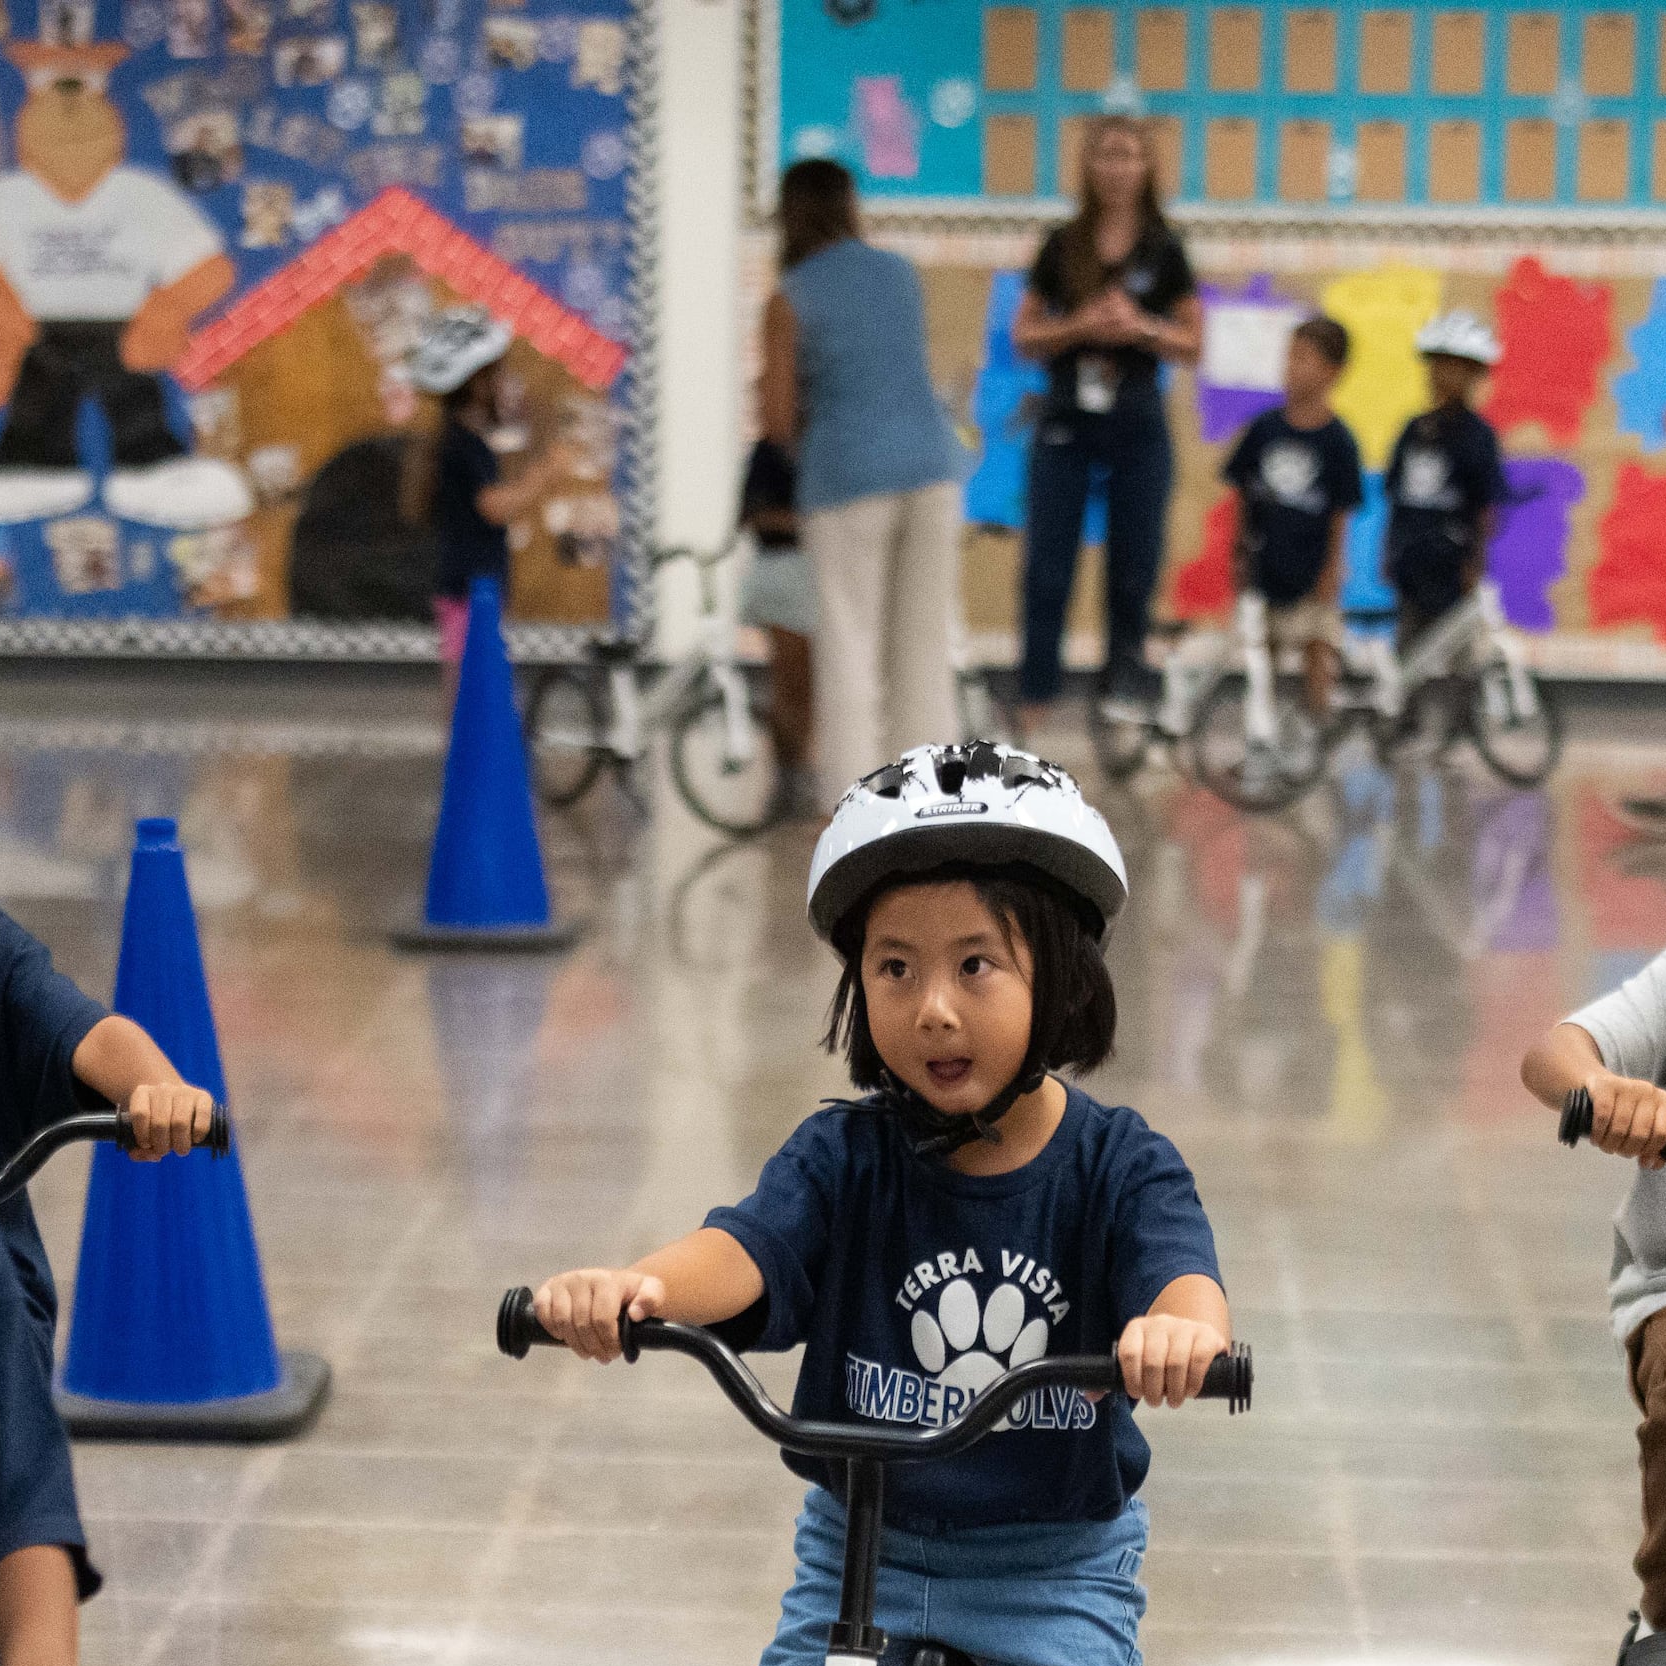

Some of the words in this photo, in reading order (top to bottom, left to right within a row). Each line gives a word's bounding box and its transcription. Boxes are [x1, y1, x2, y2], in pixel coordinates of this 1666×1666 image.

[918, 802, 983, 818] STRIDER
[895, 1248, 984, 1312] TERRA
[1001, 1249, 1071, 1326] VISTA
[845, 1350, 1097, 1430] TIMBEROLVS
